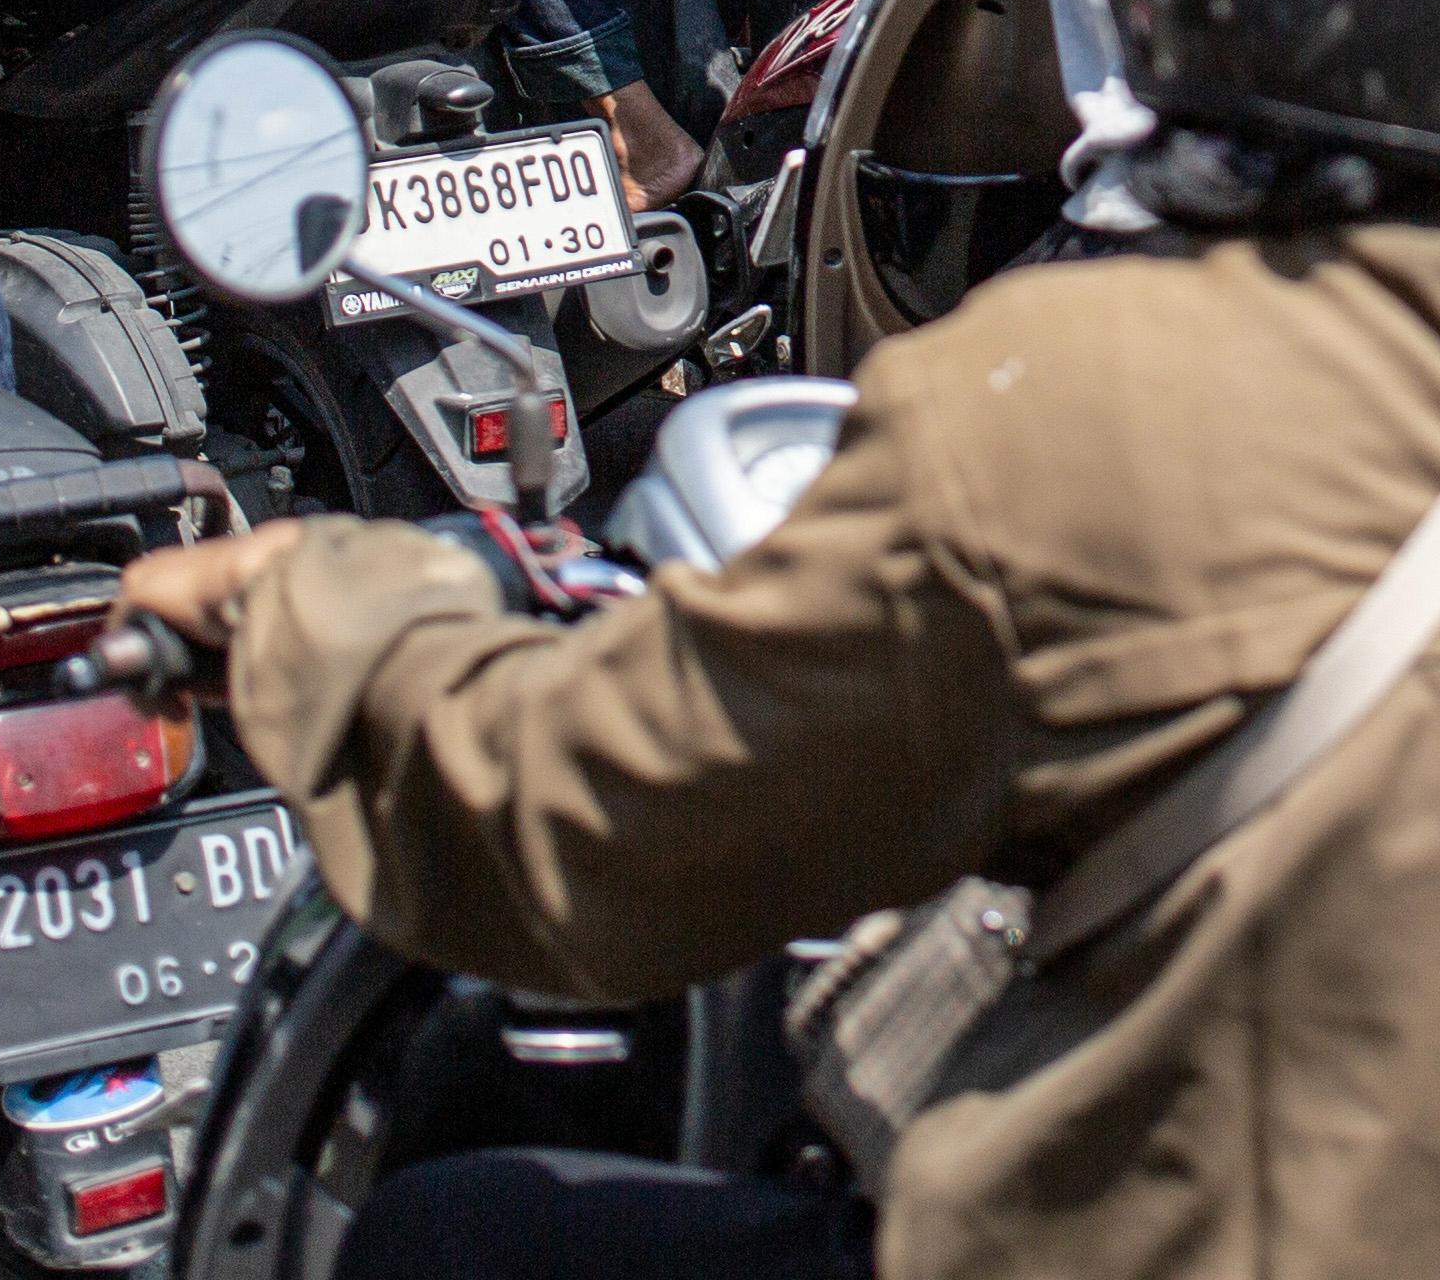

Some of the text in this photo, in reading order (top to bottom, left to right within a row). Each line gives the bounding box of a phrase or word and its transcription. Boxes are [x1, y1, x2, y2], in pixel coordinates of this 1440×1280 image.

[358, 149, 598, 234] K3868FDQ
[495, 271, 564, 294] SEMAKIN
[564, 269, 581, 283] DI
[581, 259, 633, 279] DEPAN
